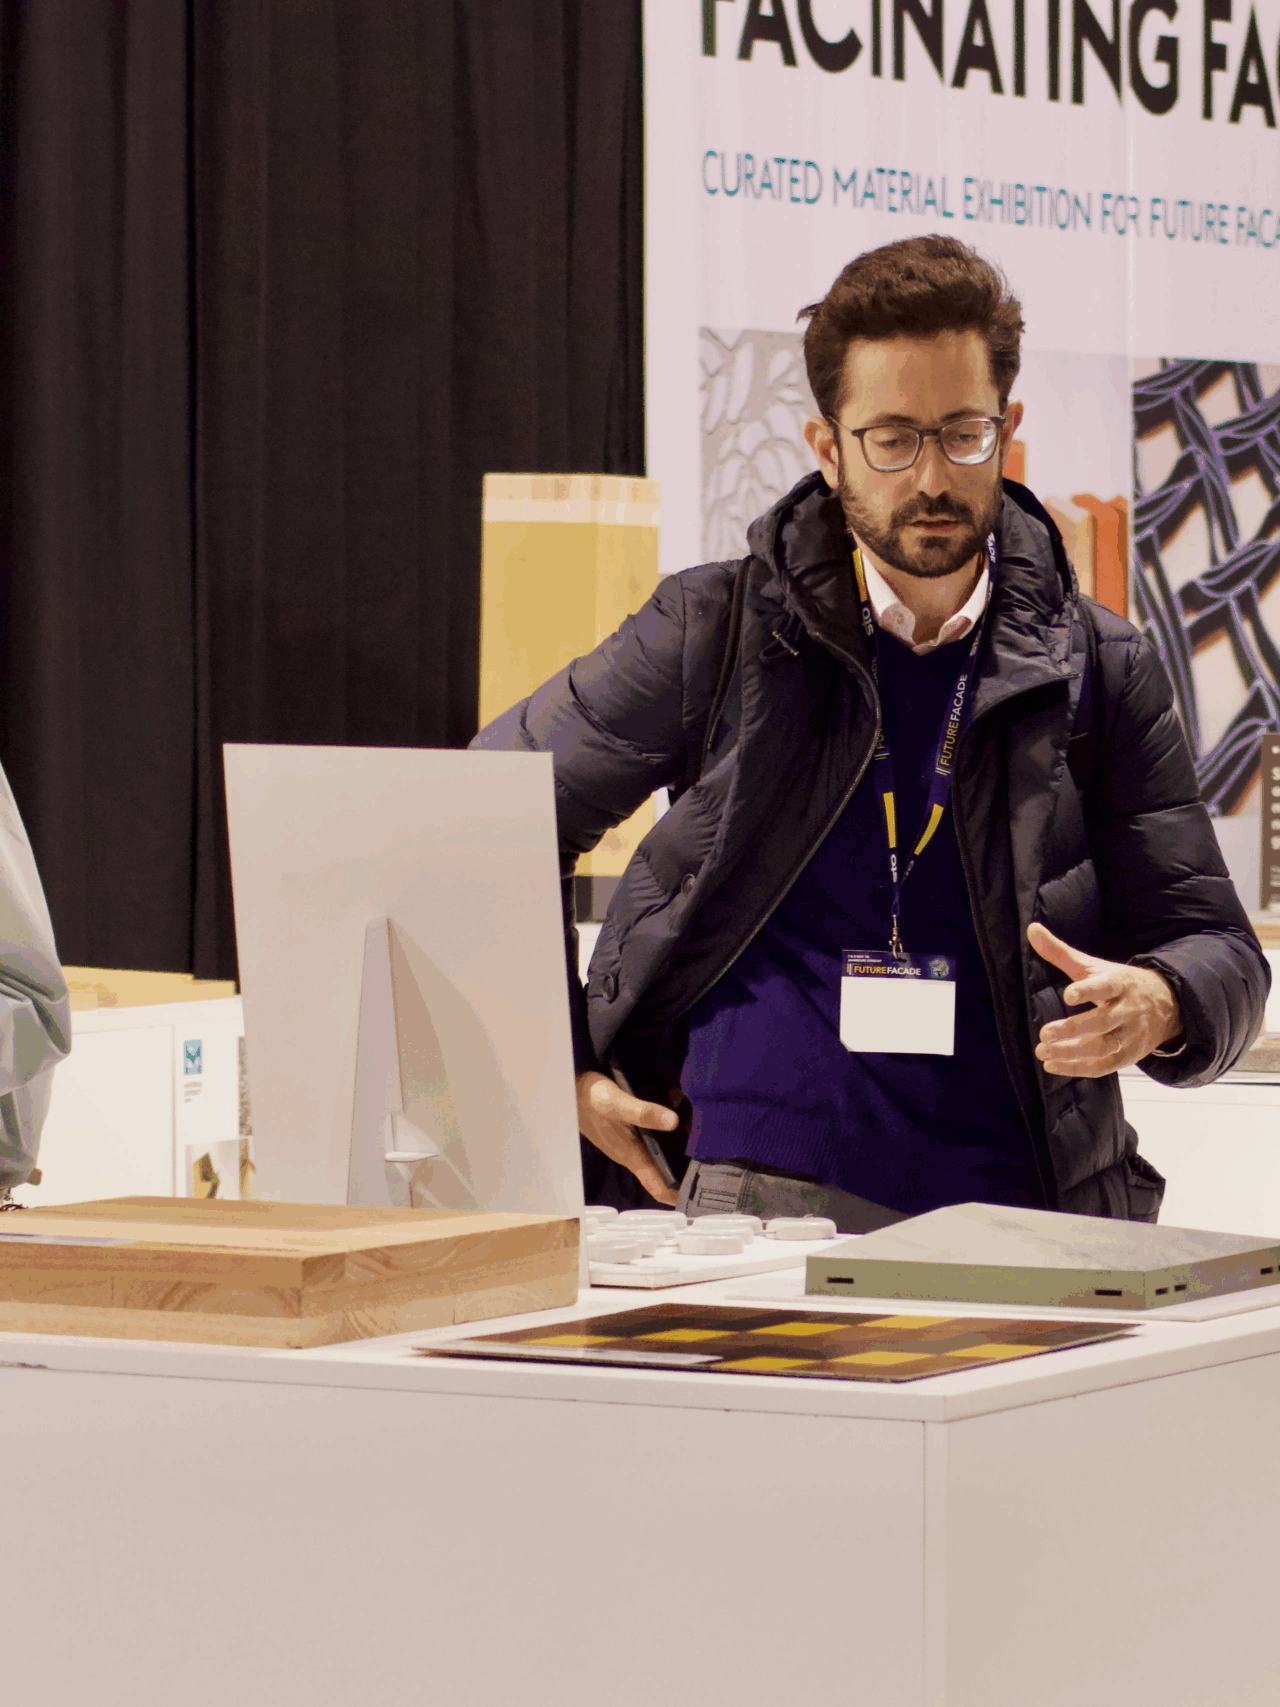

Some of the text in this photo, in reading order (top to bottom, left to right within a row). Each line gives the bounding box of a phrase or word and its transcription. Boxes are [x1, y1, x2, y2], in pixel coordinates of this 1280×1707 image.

[702, 150, 822, 204] CURATED
[833, 167, 954, 219] MATERIAL
[964, 177, 1092, 233] EXHIBITION
[1101, 192, 1139, 239] FOR
[1150, 197, 1230, 245] FUTURE
[940, 673, 968, 767] FUTUREFACADE
[854, 965, 921, 976] FUTUREFACADE
